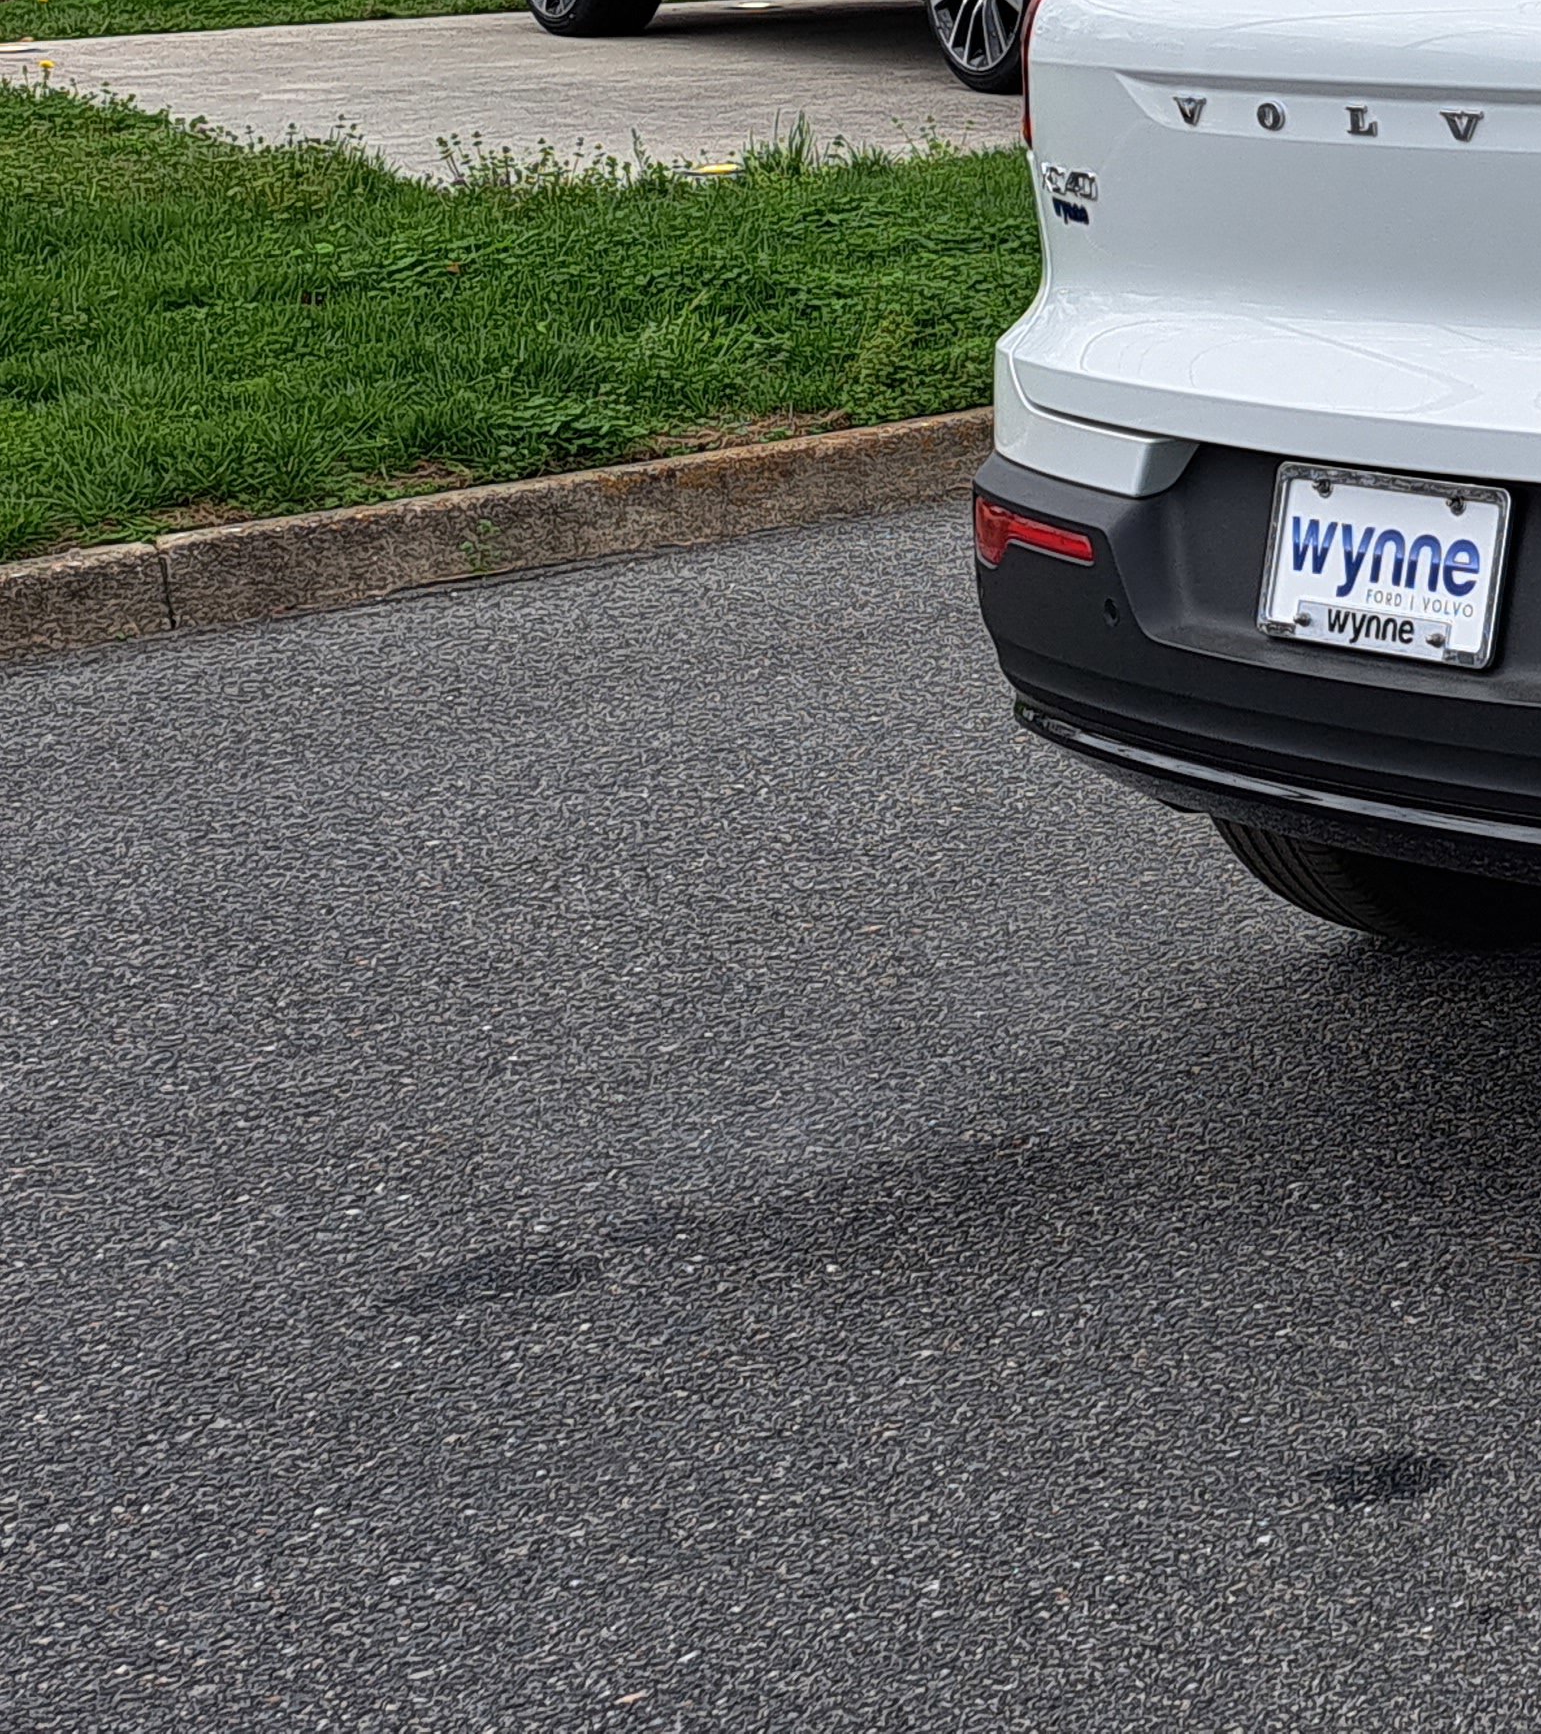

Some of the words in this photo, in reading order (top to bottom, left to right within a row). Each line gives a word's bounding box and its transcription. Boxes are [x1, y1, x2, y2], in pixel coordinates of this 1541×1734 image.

[1291, 515, 1481, 598] wynne
[1365, 588, 1403, 607] FORD
[1422, 597, 1474, 618] VOLVO
[1326, 608, 1415, 644] wynne
